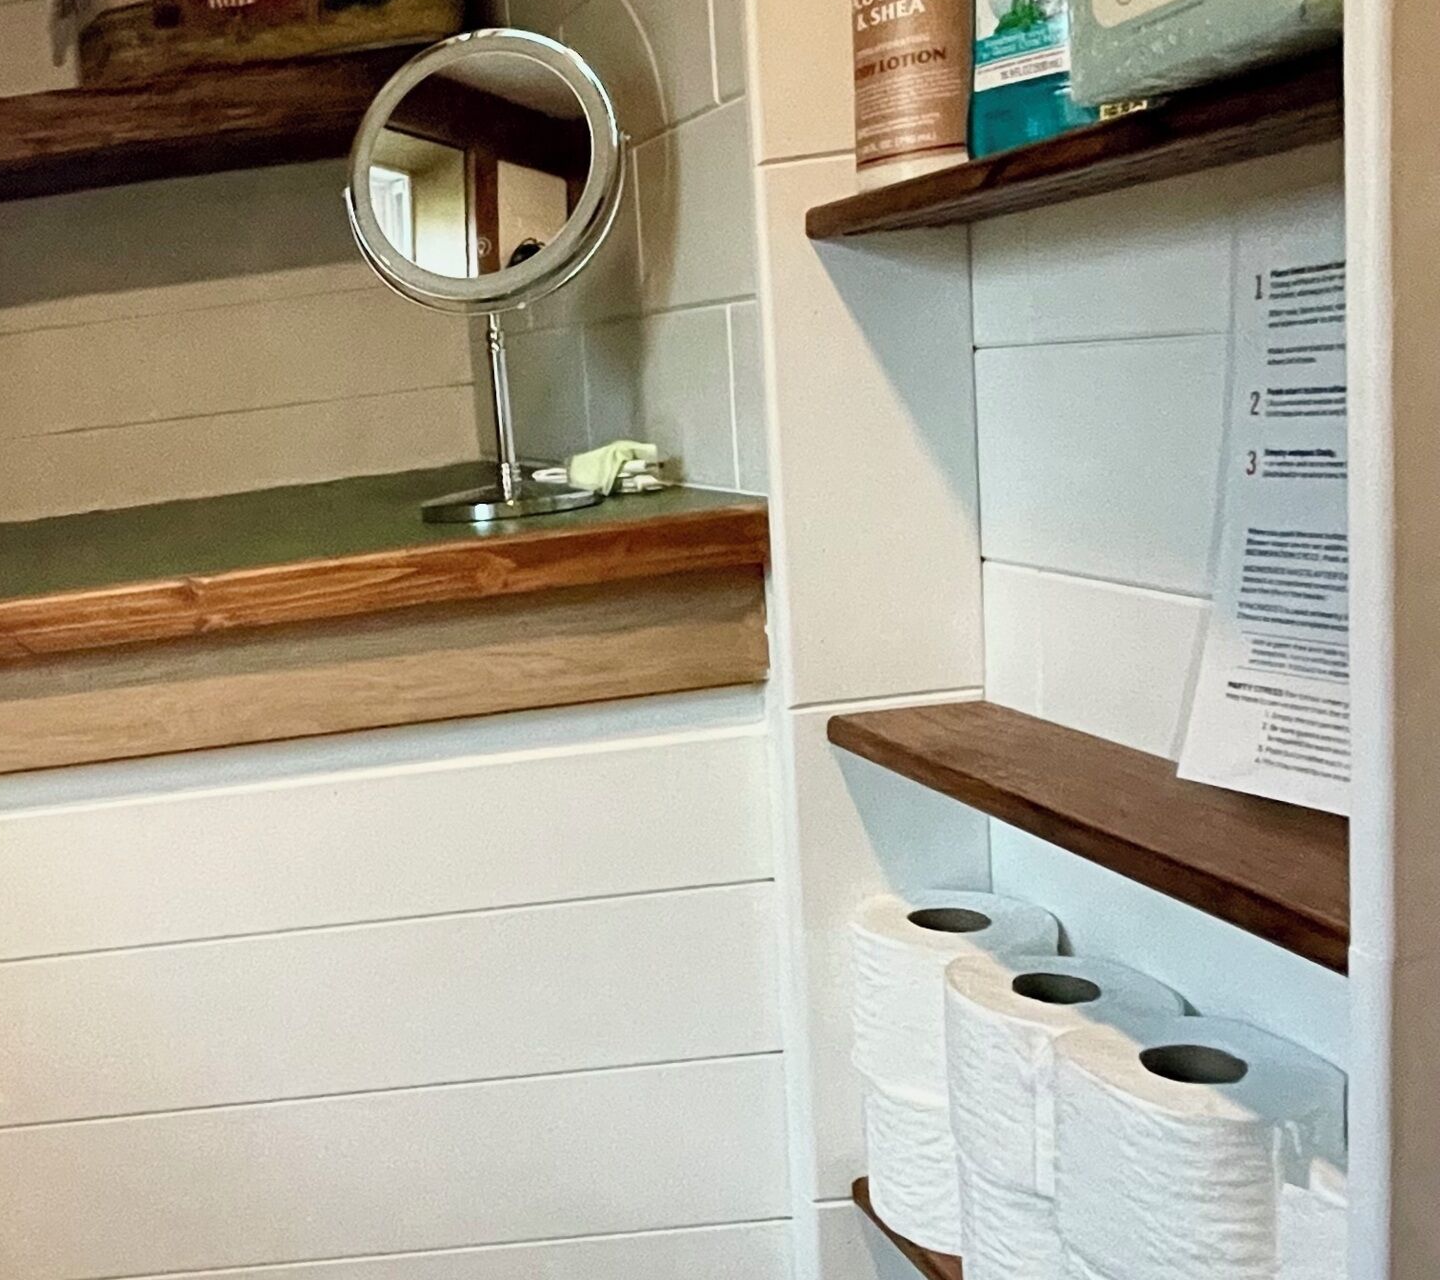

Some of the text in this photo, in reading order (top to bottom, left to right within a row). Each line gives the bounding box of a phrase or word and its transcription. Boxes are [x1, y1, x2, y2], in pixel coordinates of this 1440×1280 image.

[879, 47, 946, 74] LOTION
[1255, 274, 1262, 300] 1
[1250, 390, 1260, 416] 2
[1246, 450, 1257, 476] 3
